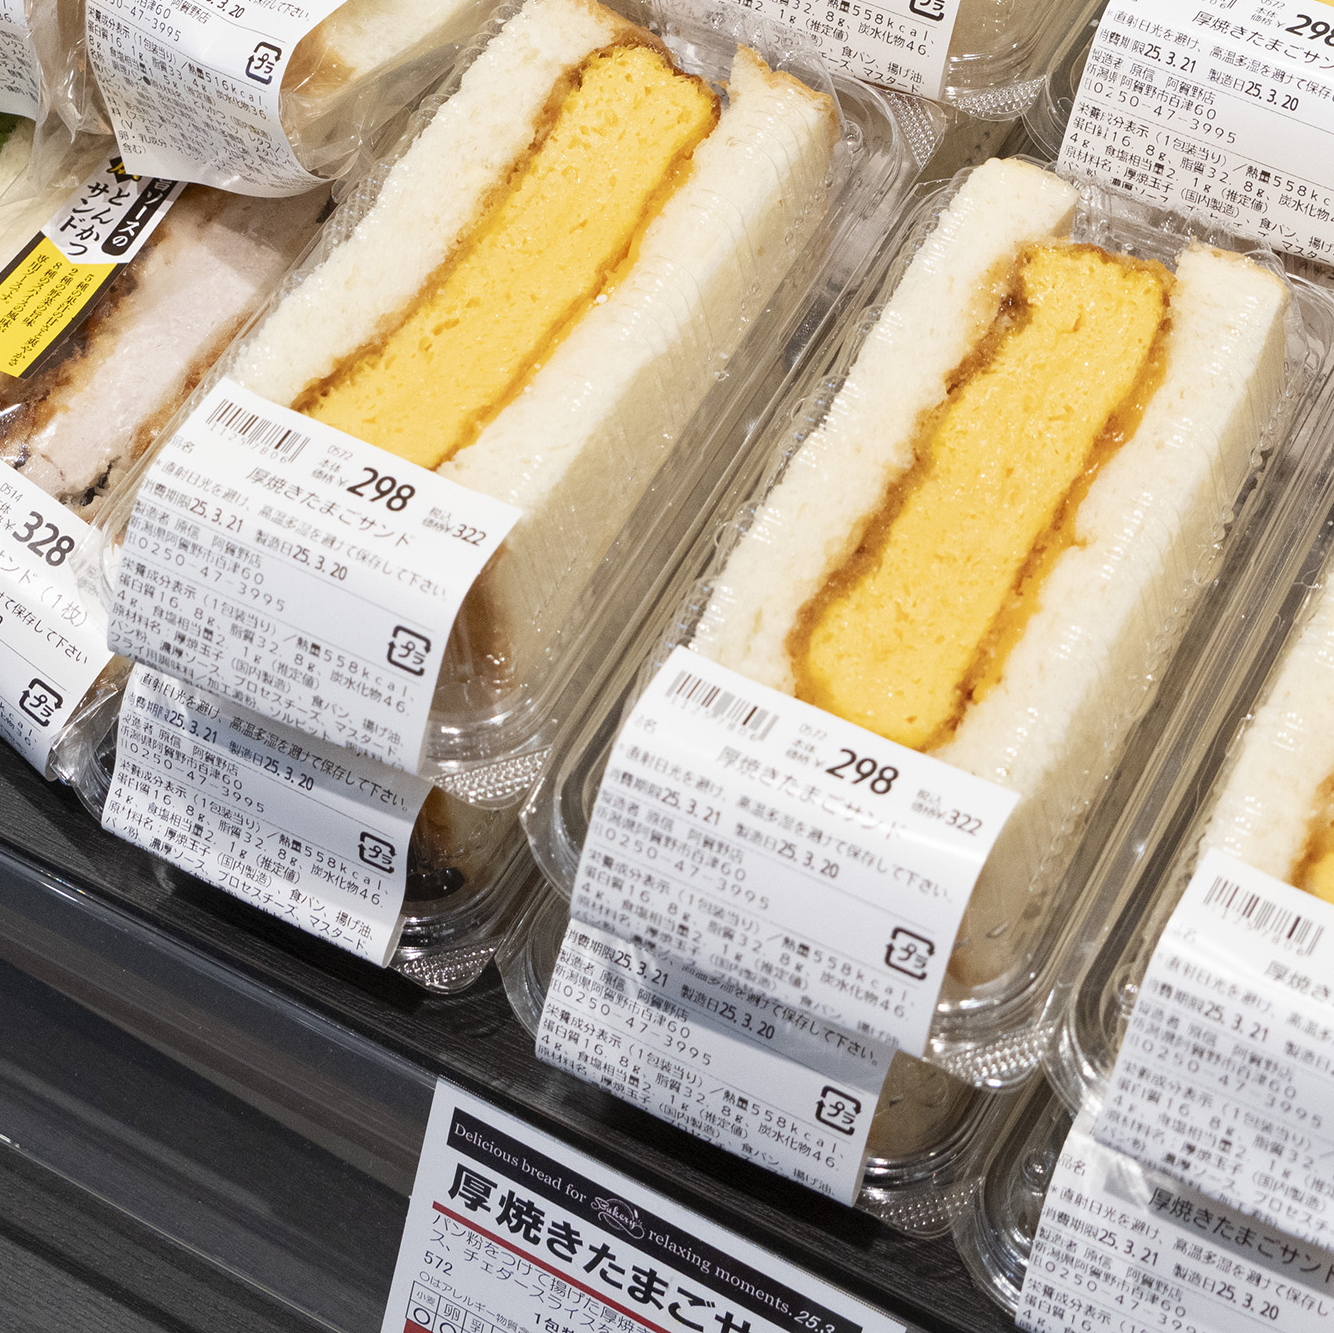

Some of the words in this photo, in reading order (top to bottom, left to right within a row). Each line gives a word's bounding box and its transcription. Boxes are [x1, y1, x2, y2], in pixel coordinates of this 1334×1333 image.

[12, 510, 75, 567] 328
[245, 466, 413, 549] 厚焼きたまごサンド
[345, 466, 416, 513] 298
[451, 523, 487, 547] 322
[825, 747, 900, 796] 298
[944, 810, 983, 837] 322
[424, 1250, 453, 1276] 572
[455, 1121, 520, 1168] Delicious
[522, 1155, 563, 1192] bread
[566, 1182, 588, 1206] for
[648, 1229, 711, 1273] relaxing
[715, 1265, 793, 1316] moments.
[794, 1310, 835, 1333] 25.3
